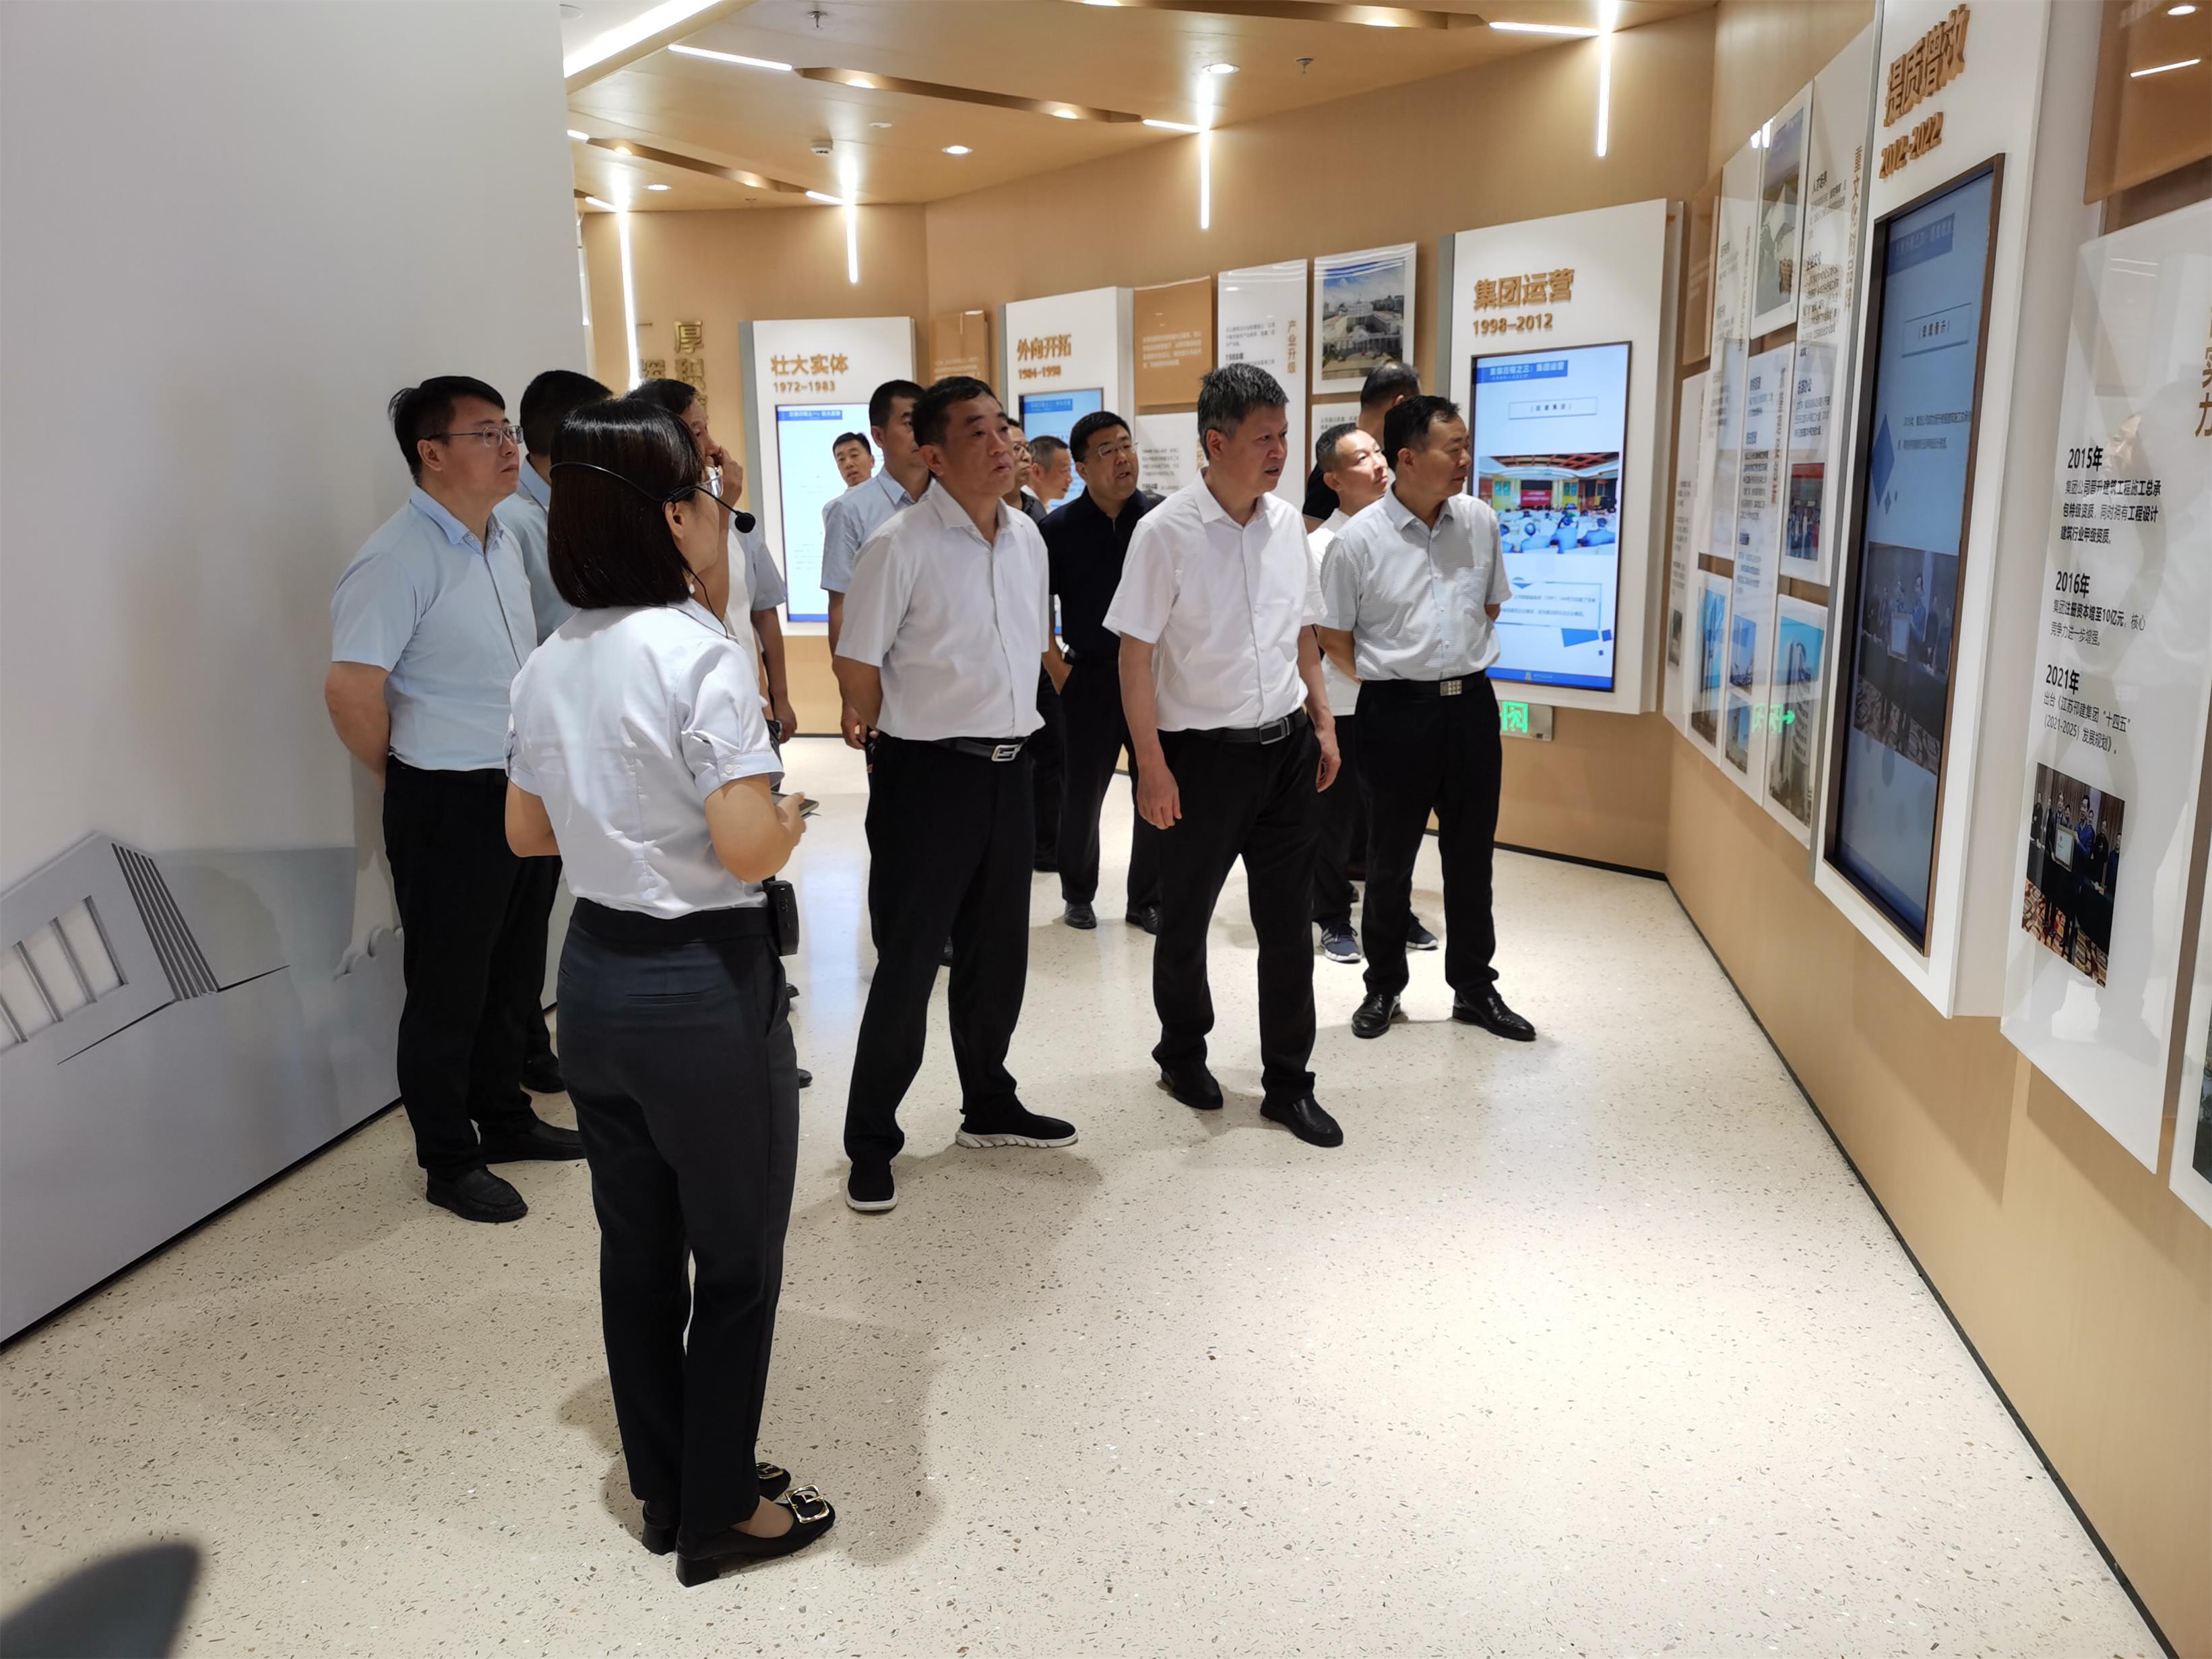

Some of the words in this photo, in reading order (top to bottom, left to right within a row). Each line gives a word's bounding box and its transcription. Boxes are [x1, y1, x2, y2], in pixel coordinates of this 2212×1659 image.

[1883, 3, 1970, 127] 提质增效
[1474, 268, 1575, 311] 集团运营
[1473, 313, 1553, 336] 1998-2012
[1017, 334, 1072, 361] 外向开拓
[770, 354, 848, 375] 壮大实体
[773, 381, 835, 393] 1972-1983
[2067, 445, 2104, 472] 2015年
[2064, 480, 2161, 497] 集团公司晋升建筑工程施工总承
[2055, 571, 2091, 598] 2016年
[2046, 664, 2080, 695] 2021年
